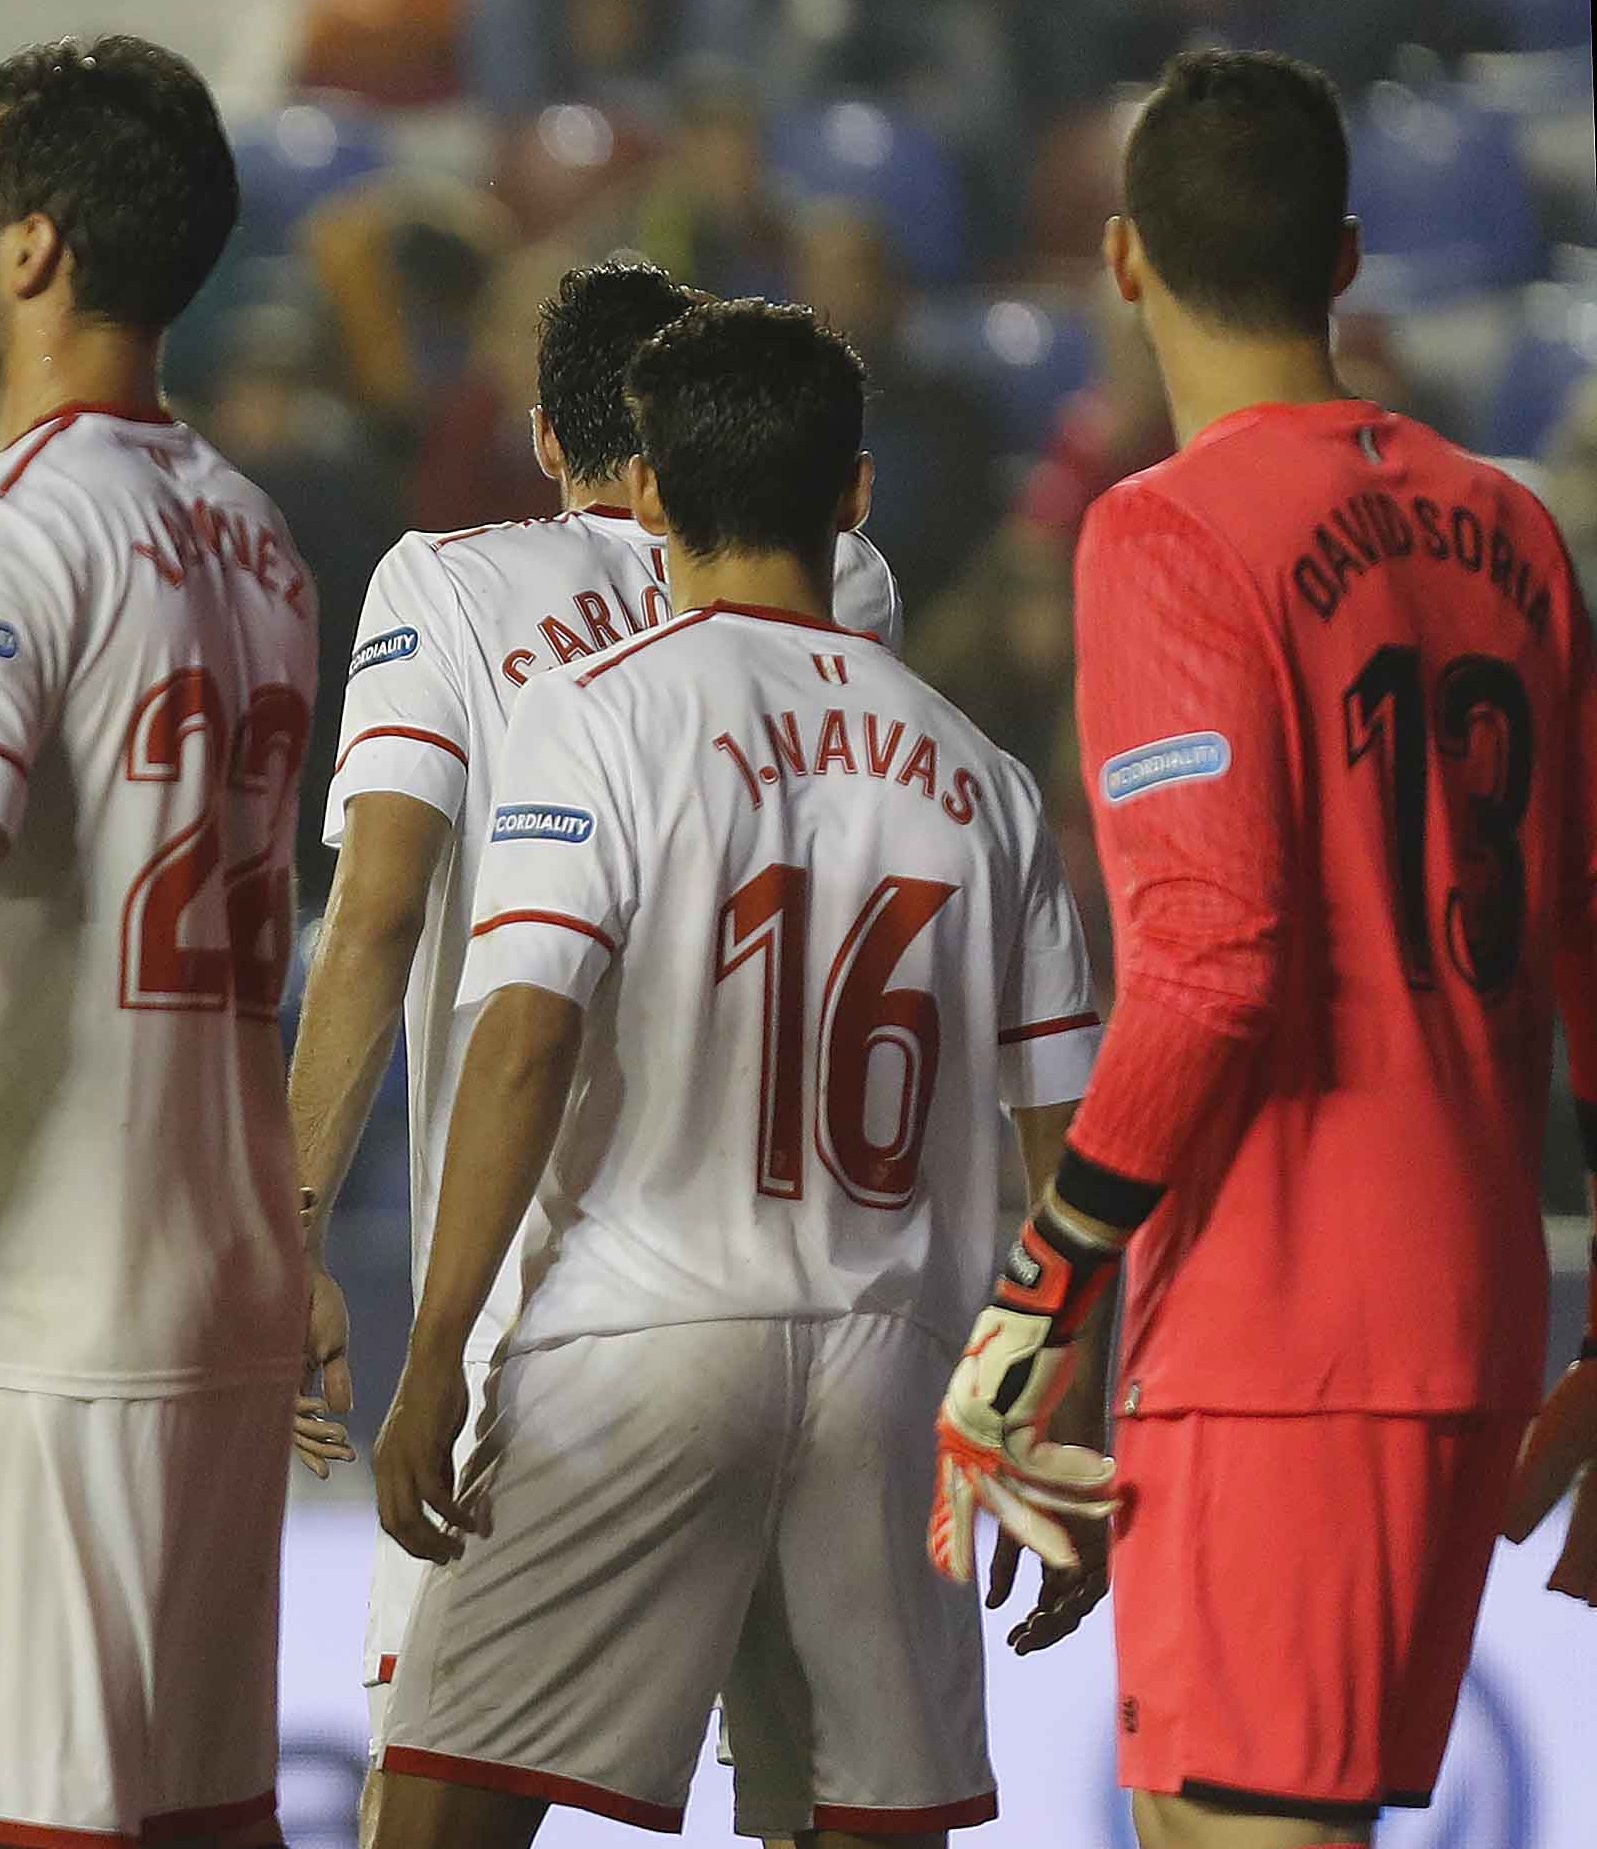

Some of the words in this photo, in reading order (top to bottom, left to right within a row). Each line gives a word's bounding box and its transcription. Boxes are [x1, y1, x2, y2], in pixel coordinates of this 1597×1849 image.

[118, 664, 310, 1018] 22
[495, 813, 590, 835] CORDIALITY
[1342, 644, 1534, 994] 13
[714, 862, 965, 1211] 16
